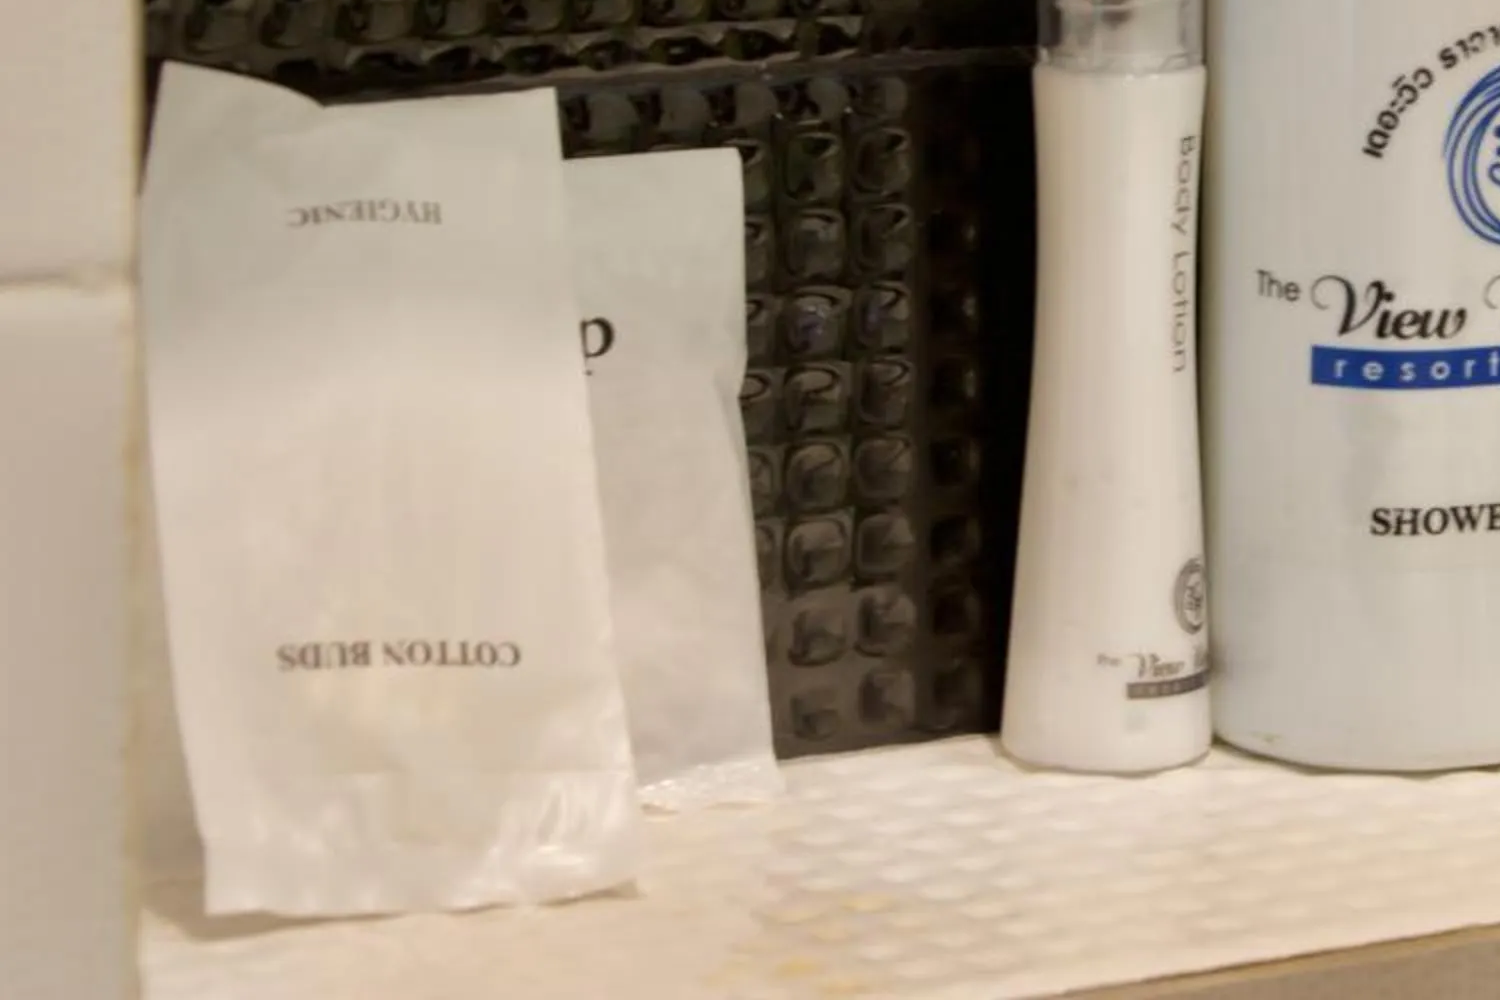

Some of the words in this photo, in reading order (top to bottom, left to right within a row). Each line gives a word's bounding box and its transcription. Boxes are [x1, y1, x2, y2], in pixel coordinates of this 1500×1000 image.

[286, 198, 443, 229] HYGIENIC
[1256, 269, 1302, 302] The
[1310, 274, 1468, 340] View
[1333, 351, 1500, 382] resort
[274, 640, 372, 673] BUDS
[382, 639, 523, 670] COTTON
